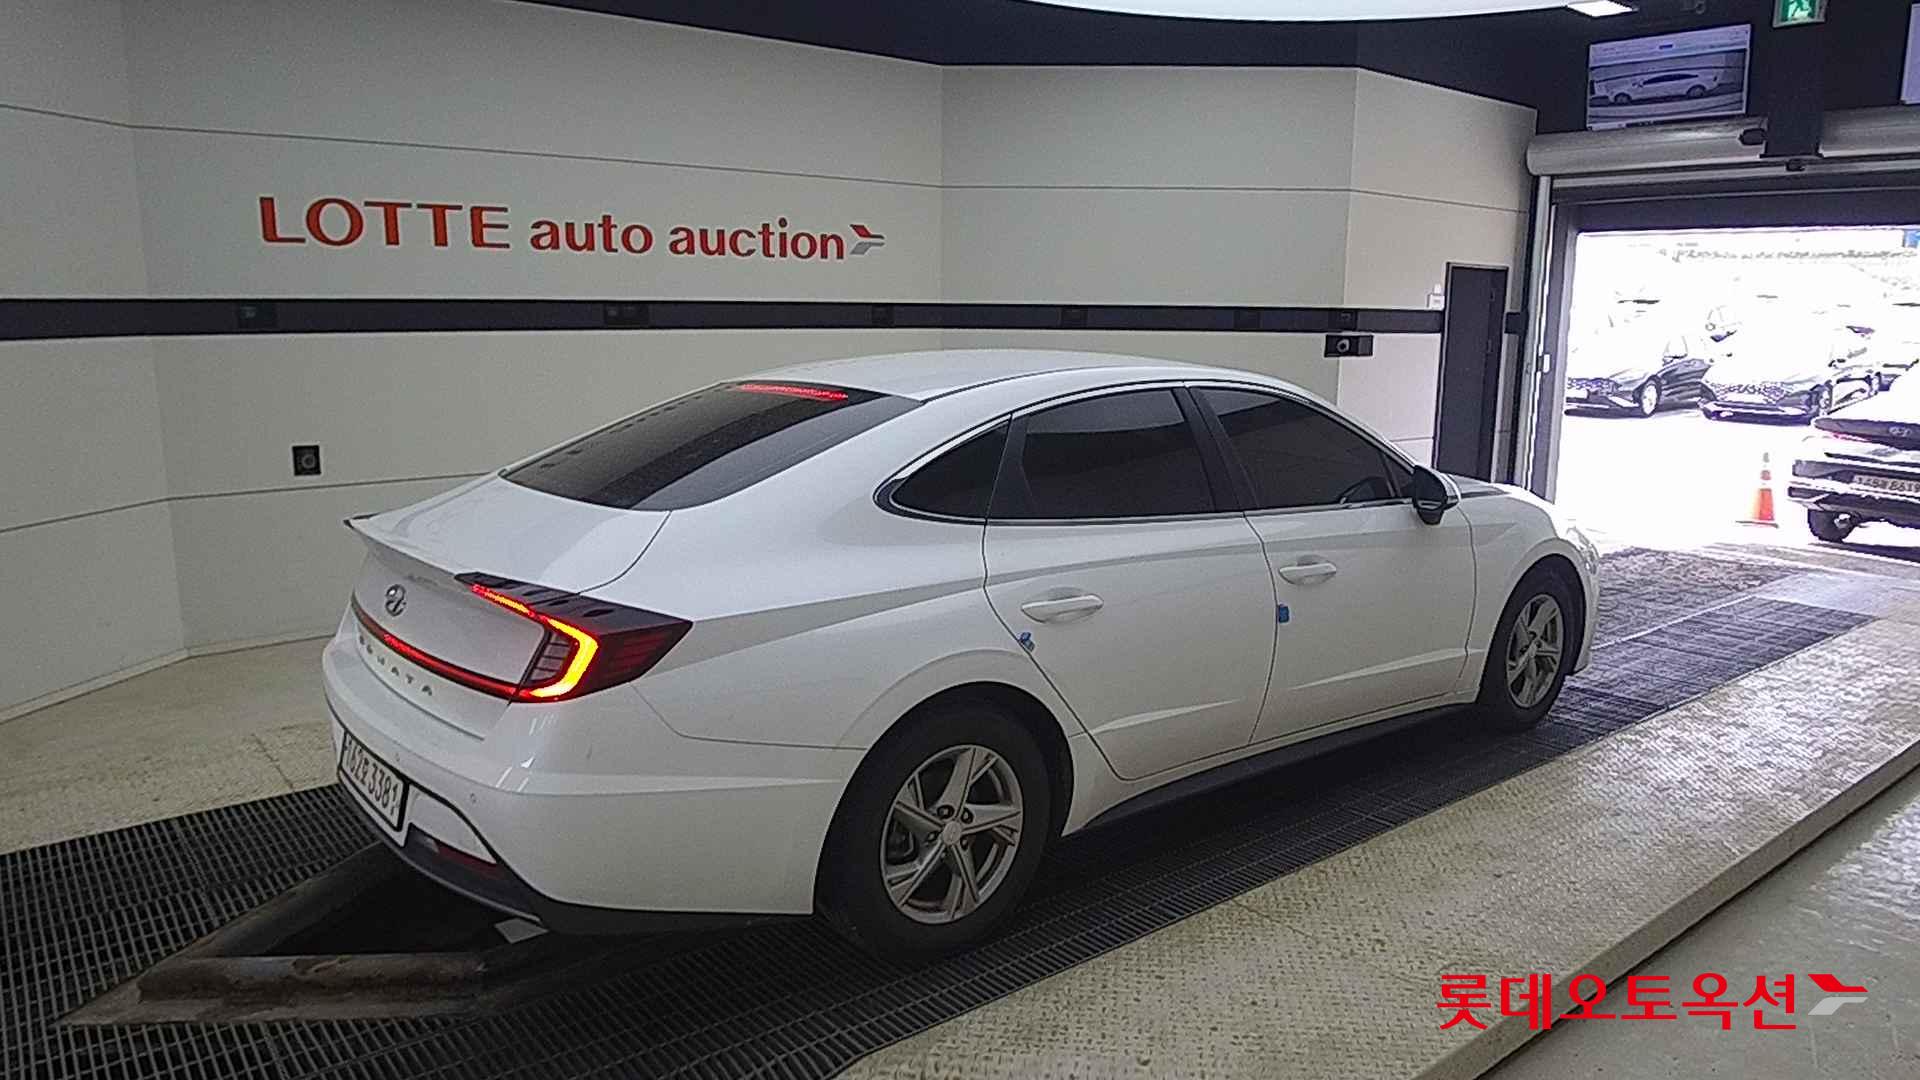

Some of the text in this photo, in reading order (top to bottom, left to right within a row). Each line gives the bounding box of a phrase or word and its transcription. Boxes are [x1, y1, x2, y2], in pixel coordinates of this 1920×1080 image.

[259, 197, 845, 260] LOTTE auto auction
[367, 762, 399, 816] 3381
